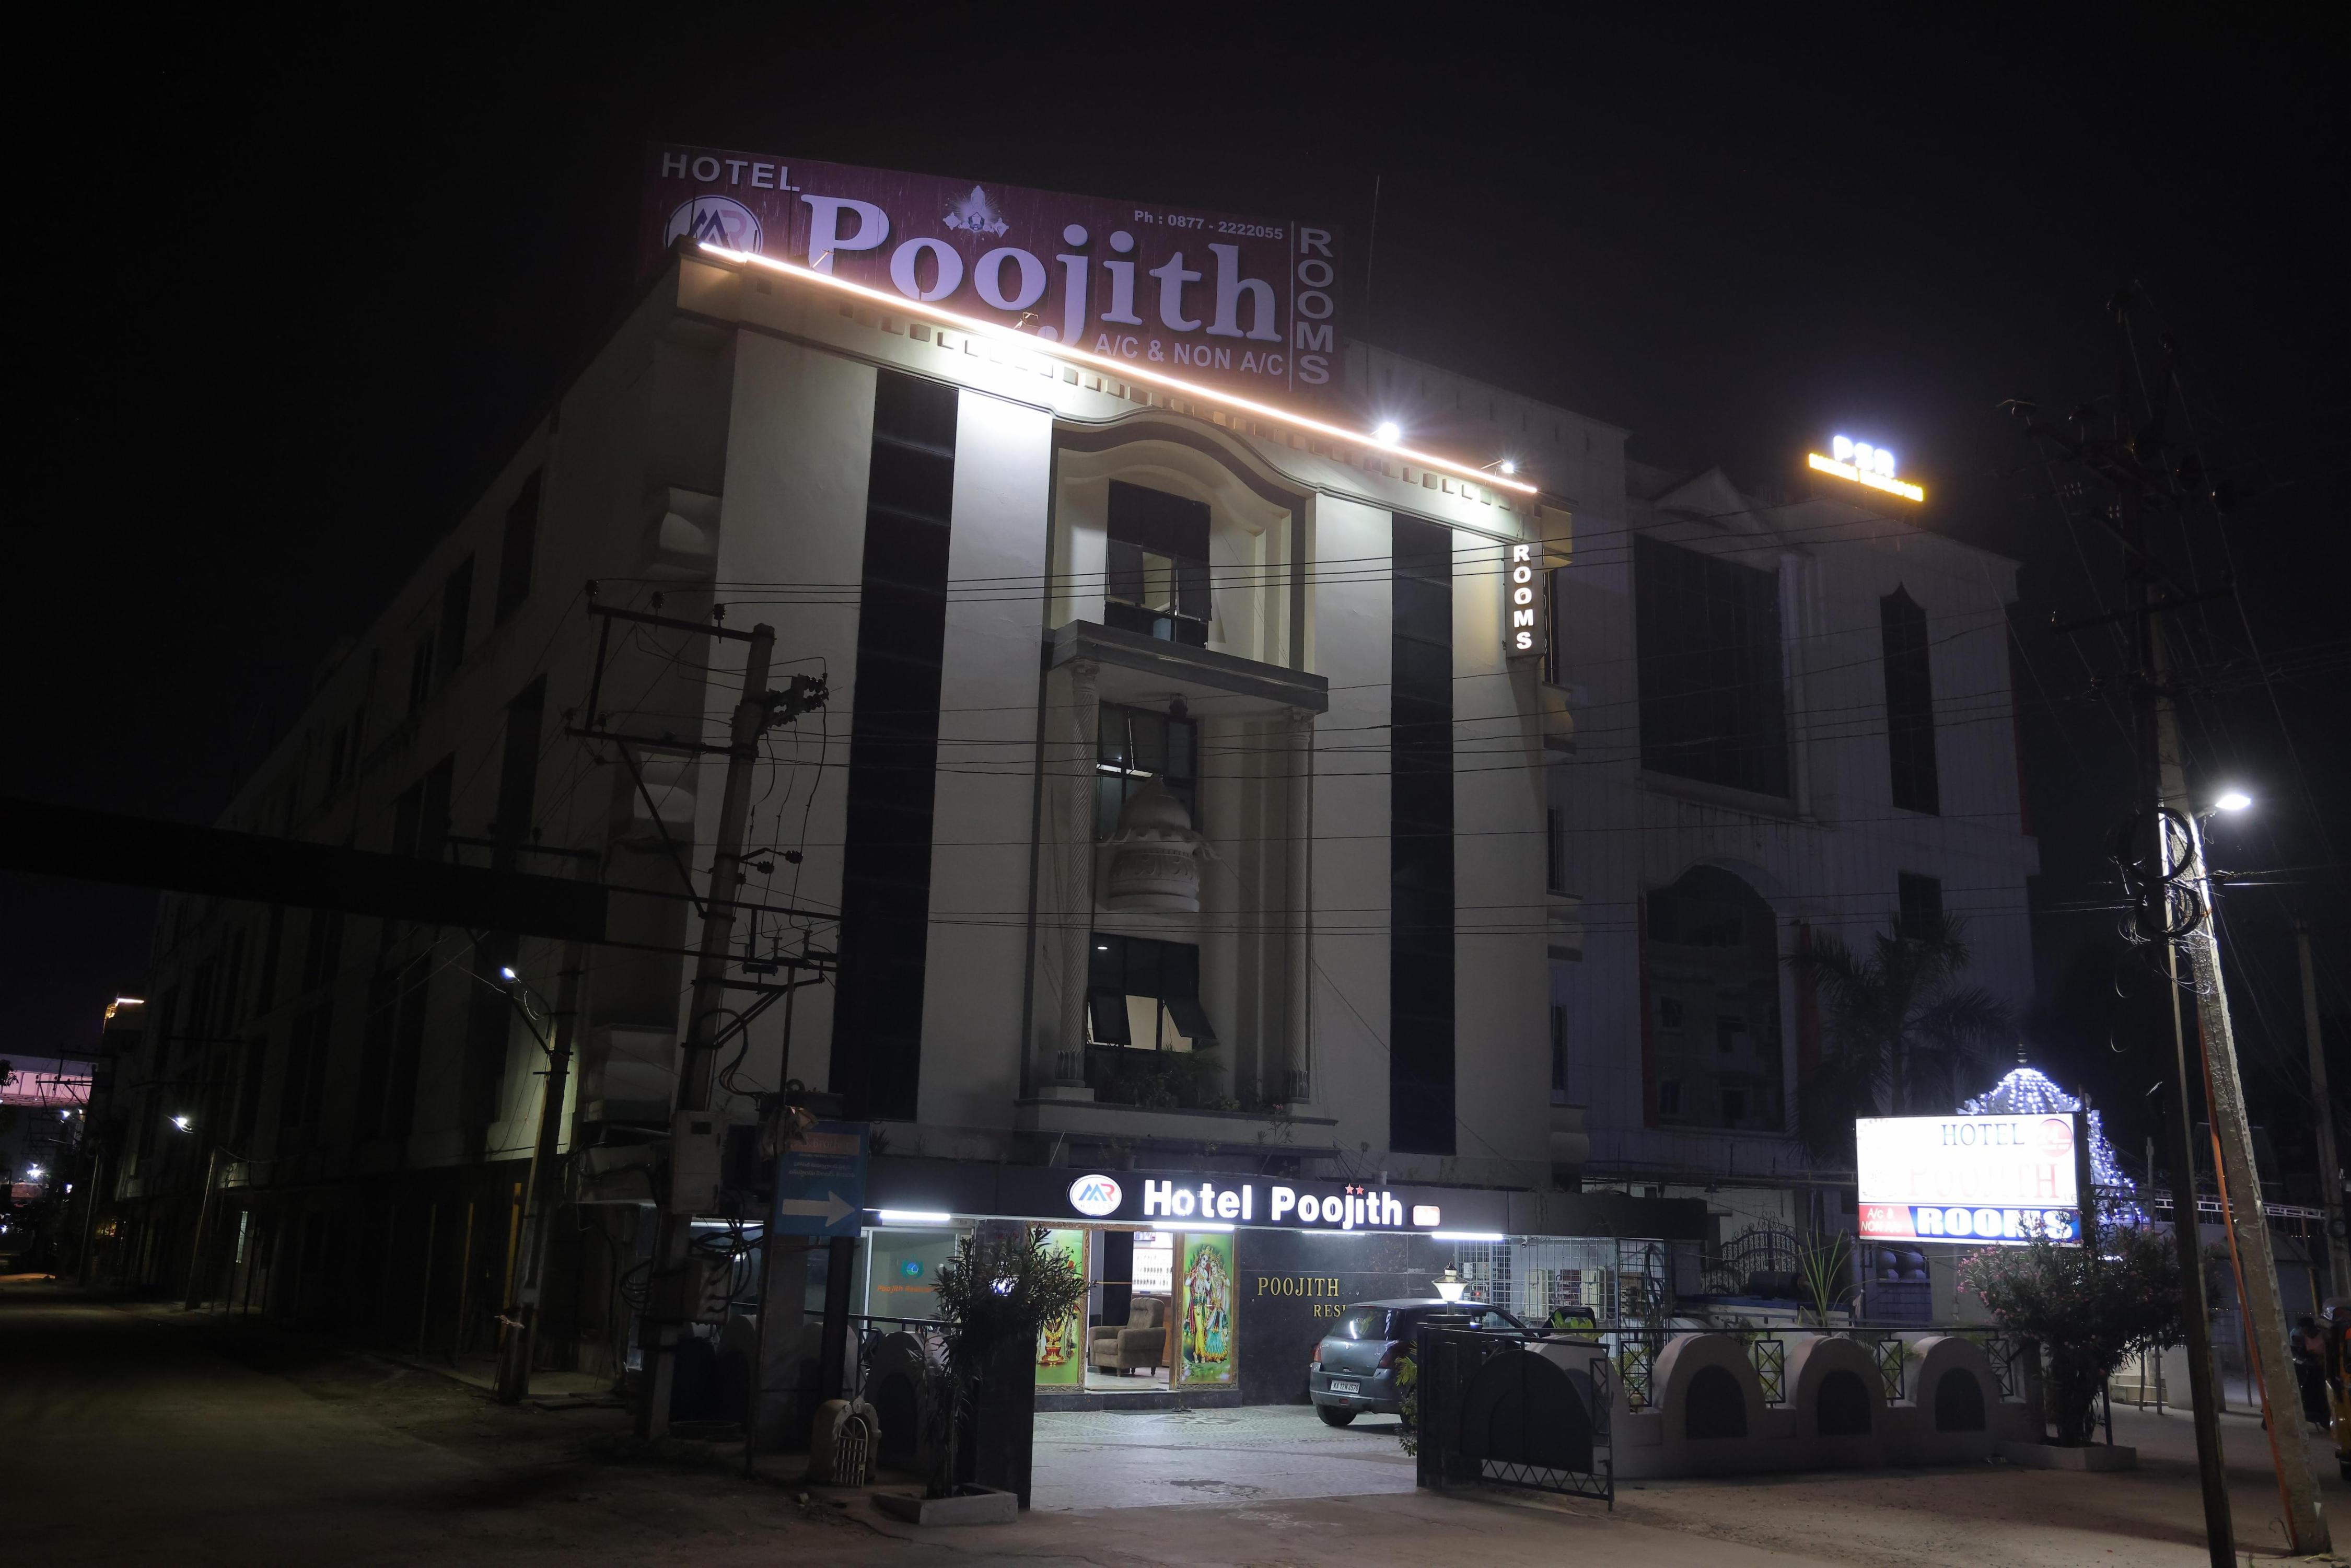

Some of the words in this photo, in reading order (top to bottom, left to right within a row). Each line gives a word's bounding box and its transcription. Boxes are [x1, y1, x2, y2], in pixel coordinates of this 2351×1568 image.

[661, 153, 800, 192] HOTEL
[1134, 210, 1153, 223] Ph
[1168, 214, 1204, 229] 0877
[1218, 221, 1283, 240] 2222055
[800, 193, 1282, 348] Poojith
[1296, 227, 1334, 385] ROOMS
[1094, 333, 1138, 358] A/C
[1147, 340, 1165, 362] &
[1174, 342, 1230, 370] NON
[1240, 351, 1283, 376] A/C
[1513, 544, 1534, 649] ROOMS
[1941, 1123, 2025, 1146] HOTEL
[1144, 1179, 1252, 1220] Hotel
[1271, 1183, 1403, 1230] Poojith
[1917, 1207, 2073, 1239] ROOMS
[1258, 1276, 1339, 1297] POOJITH
